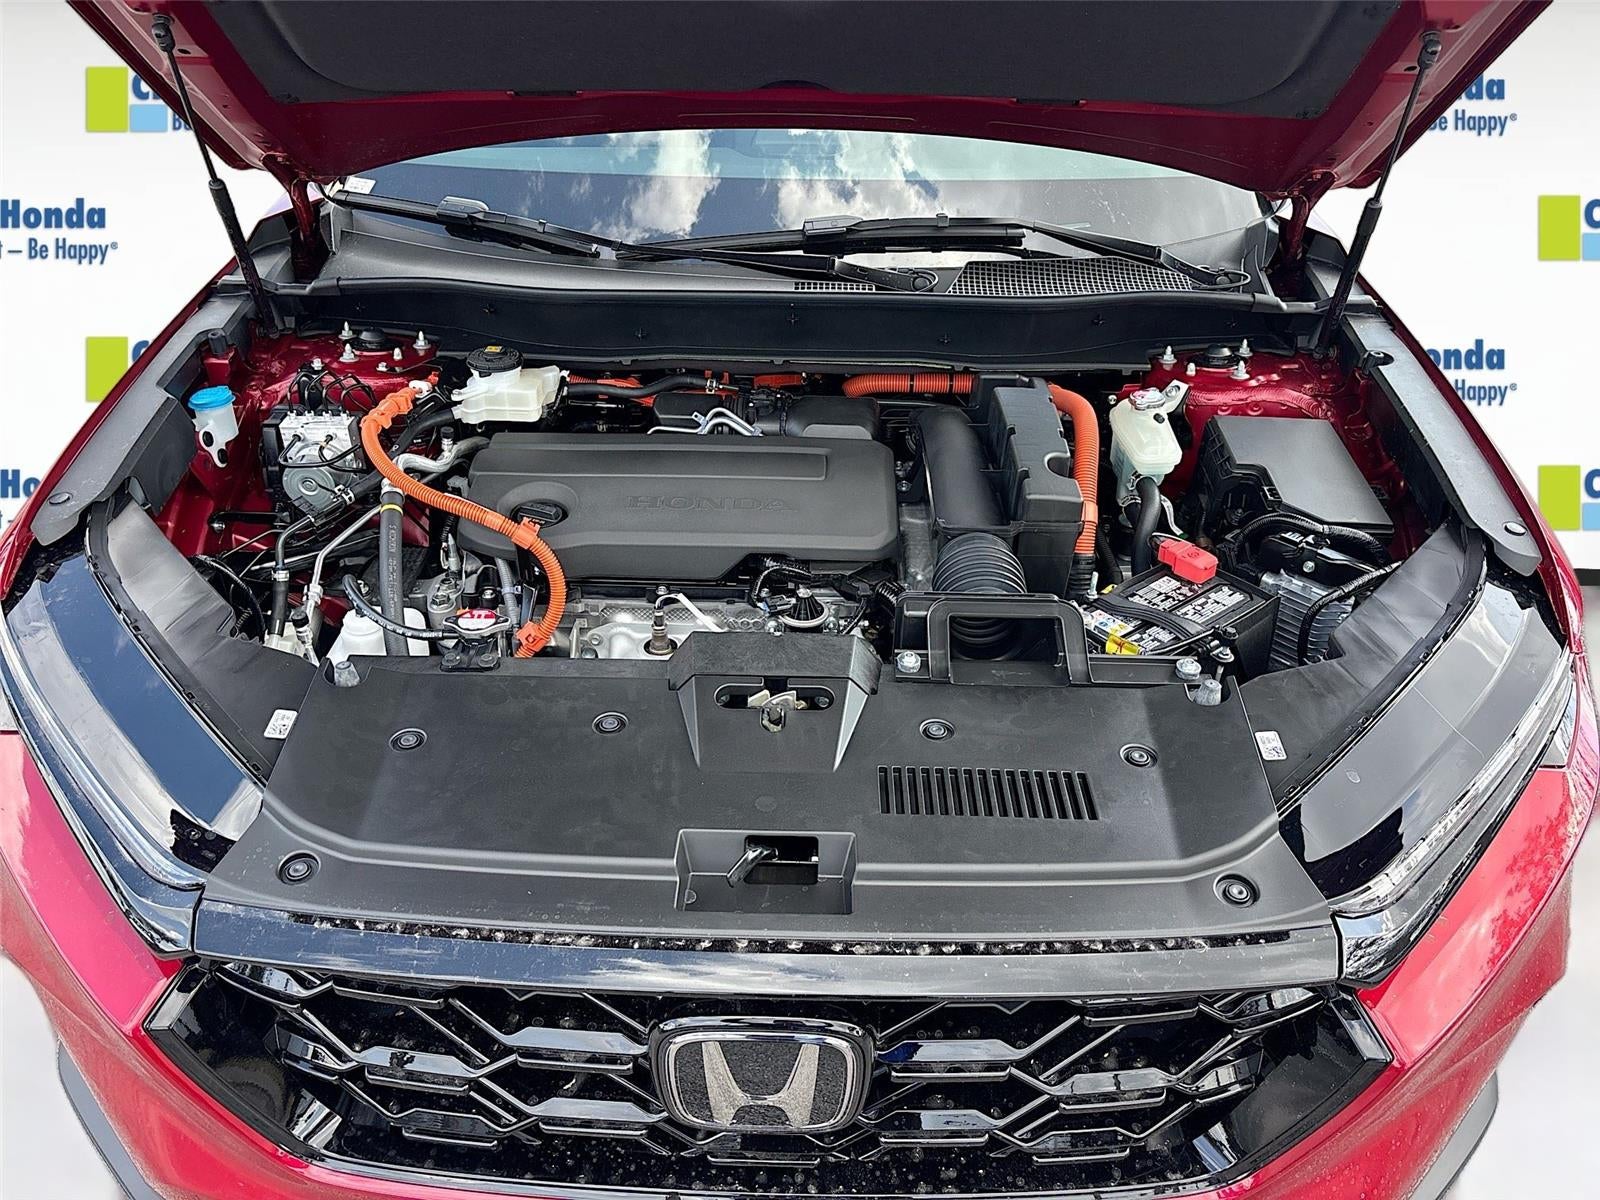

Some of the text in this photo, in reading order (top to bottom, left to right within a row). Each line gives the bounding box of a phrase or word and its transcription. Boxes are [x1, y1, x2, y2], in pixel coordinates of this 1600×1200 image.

[1458, 74, 1505, 100] da
[0, 198, 106, 229] Honda
[28, 238, 49, 260] Be
[625, 495, 798, 512] HONDA
